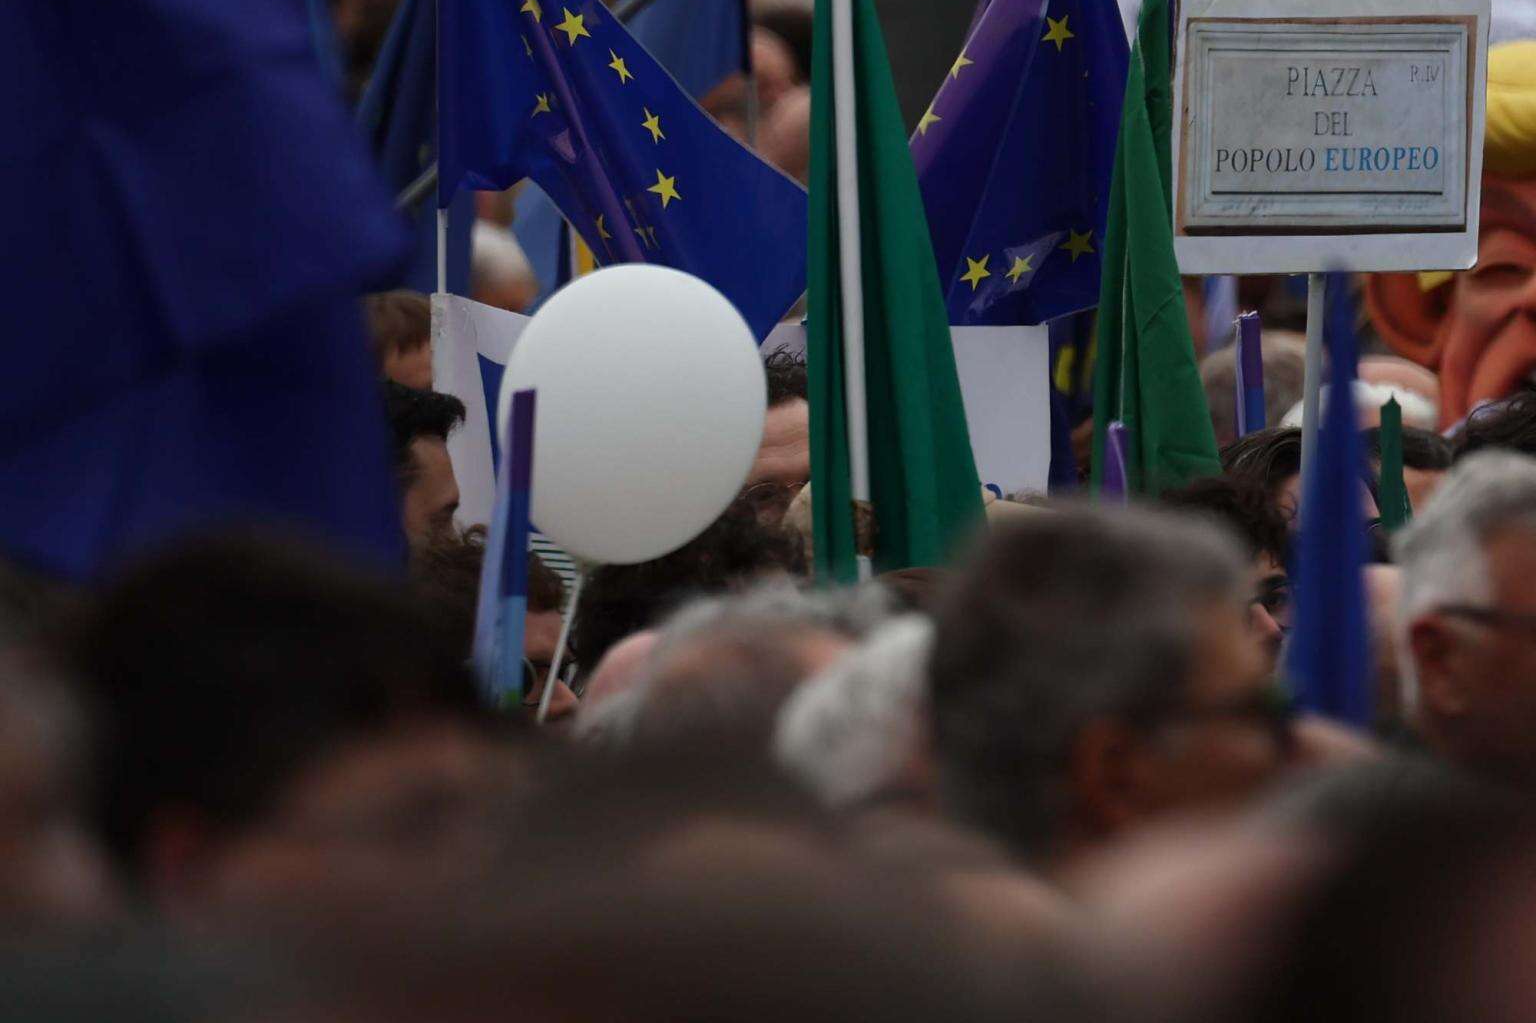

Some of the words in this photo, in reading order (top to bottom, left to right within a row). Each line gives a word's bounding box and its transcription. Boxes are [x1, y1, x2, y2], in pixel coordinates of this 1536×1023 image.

[1286, 66, 1378, 96] PIAZZA
[1314, 111, 1353, 136] DEL
[1215, 148, 1315, 173] POPOLO
[1324, 146, 1439, 172] EUROPEO
